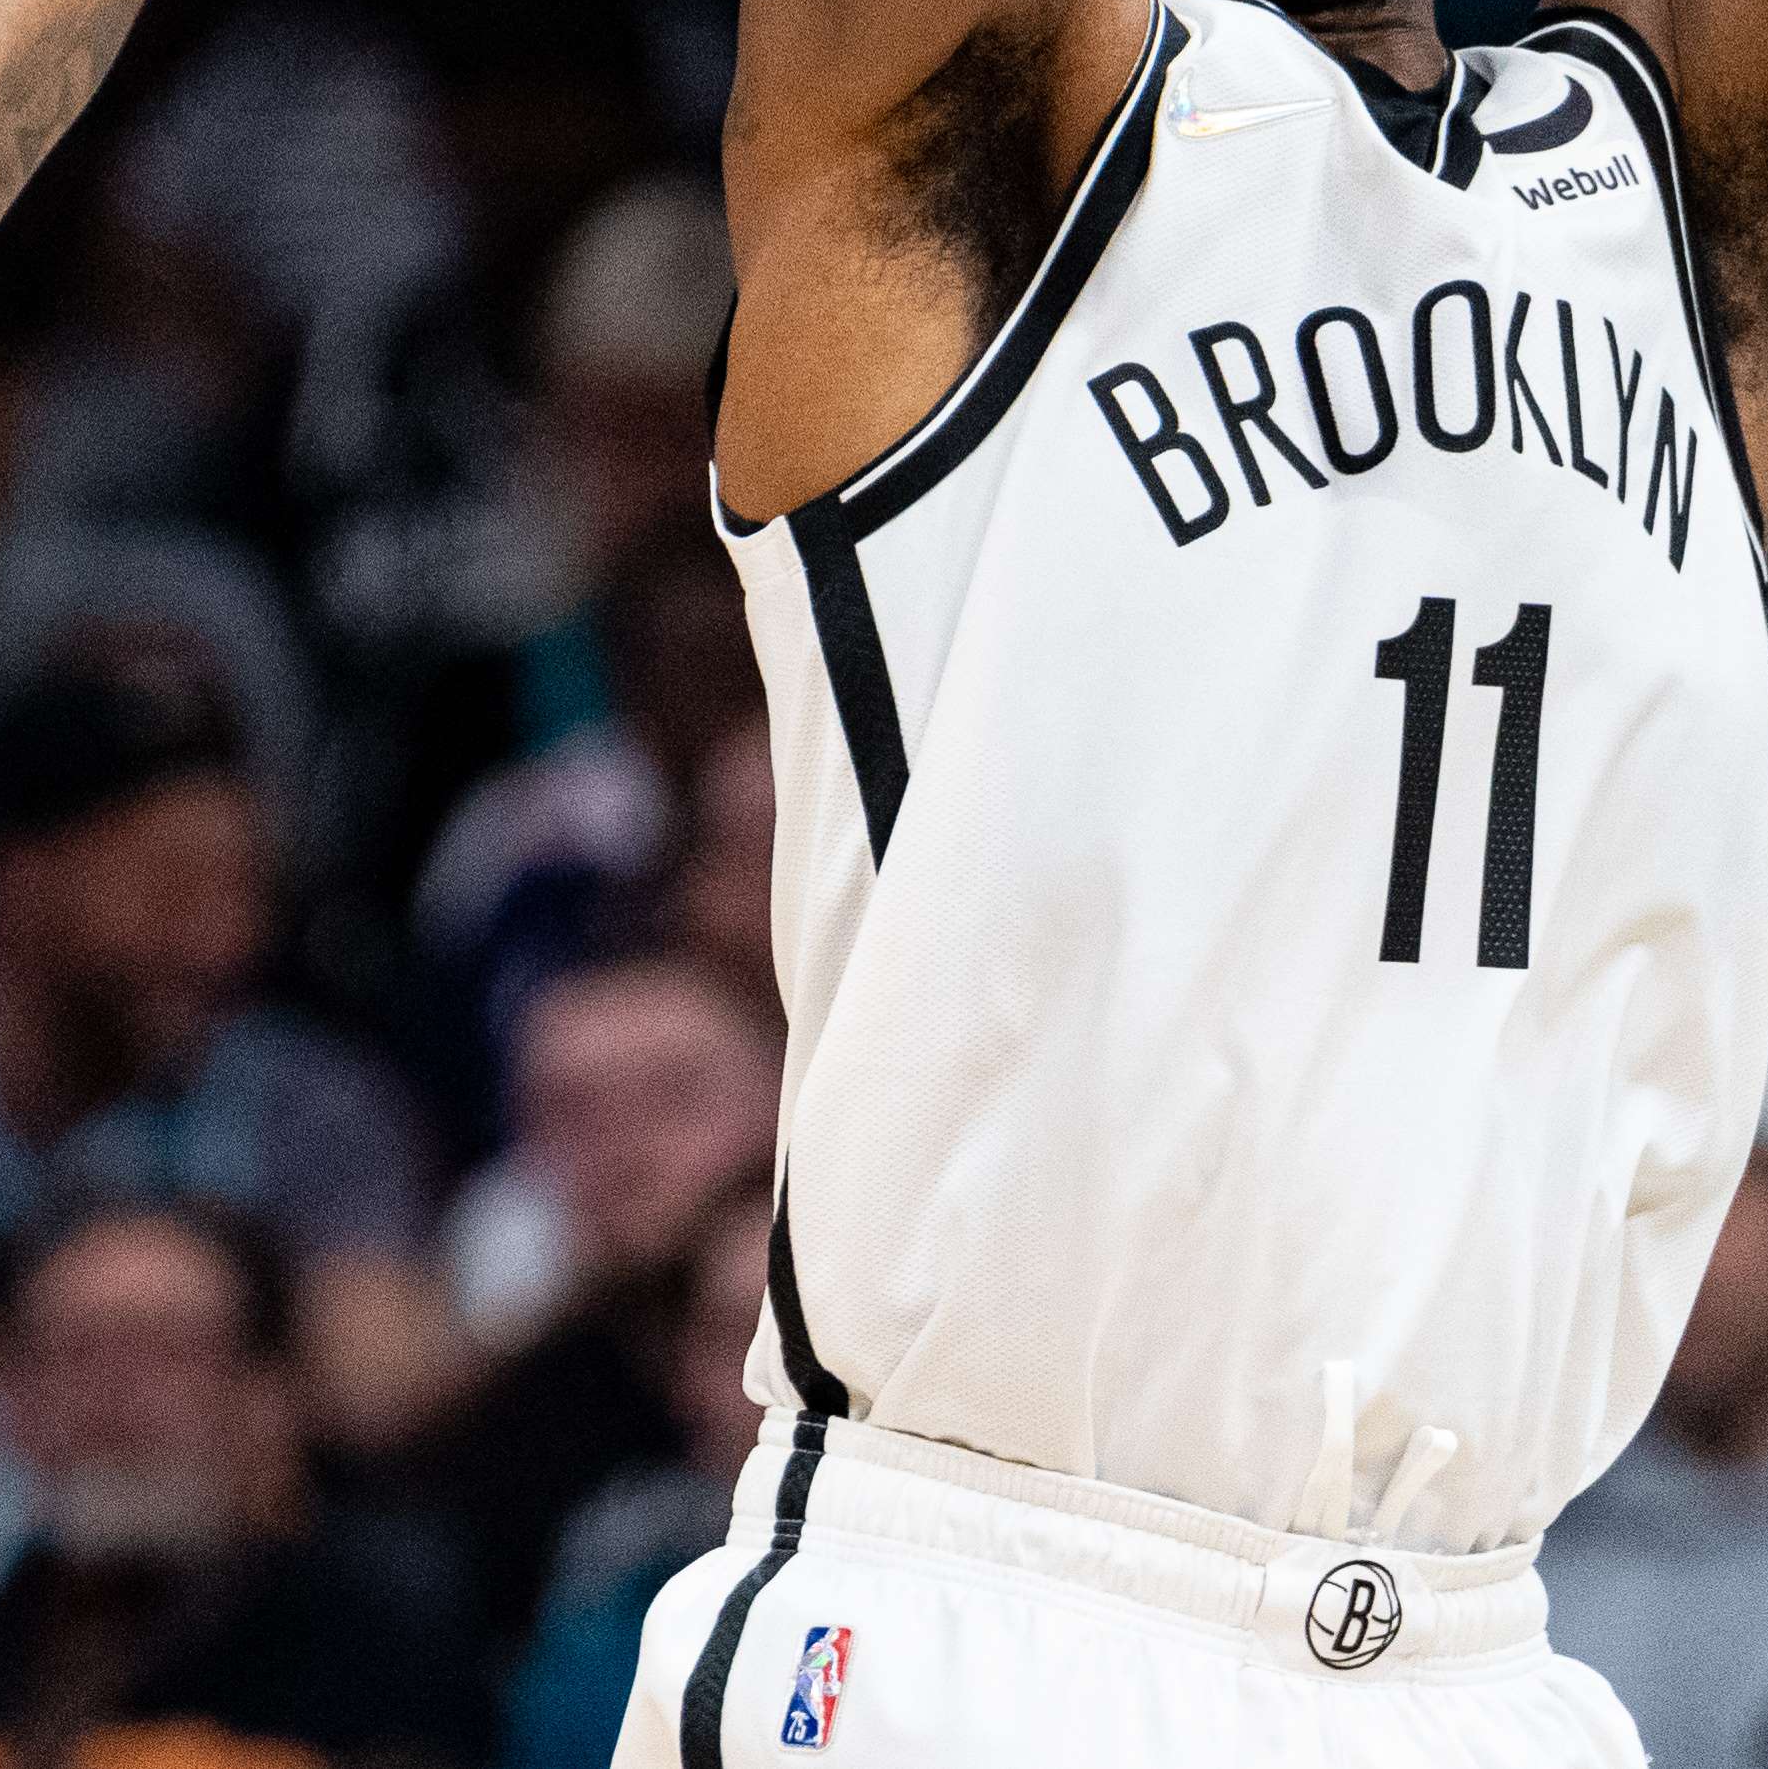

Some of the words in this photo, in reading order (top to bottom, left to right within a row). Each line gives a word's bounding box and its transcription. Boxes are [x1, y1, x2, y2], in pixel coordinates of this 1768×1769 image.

[1510, 153, 1640, 211] Webull
[1086, 278, 1698, 574] BROOKLYN
[1373, 595, 1553, 970] 11
